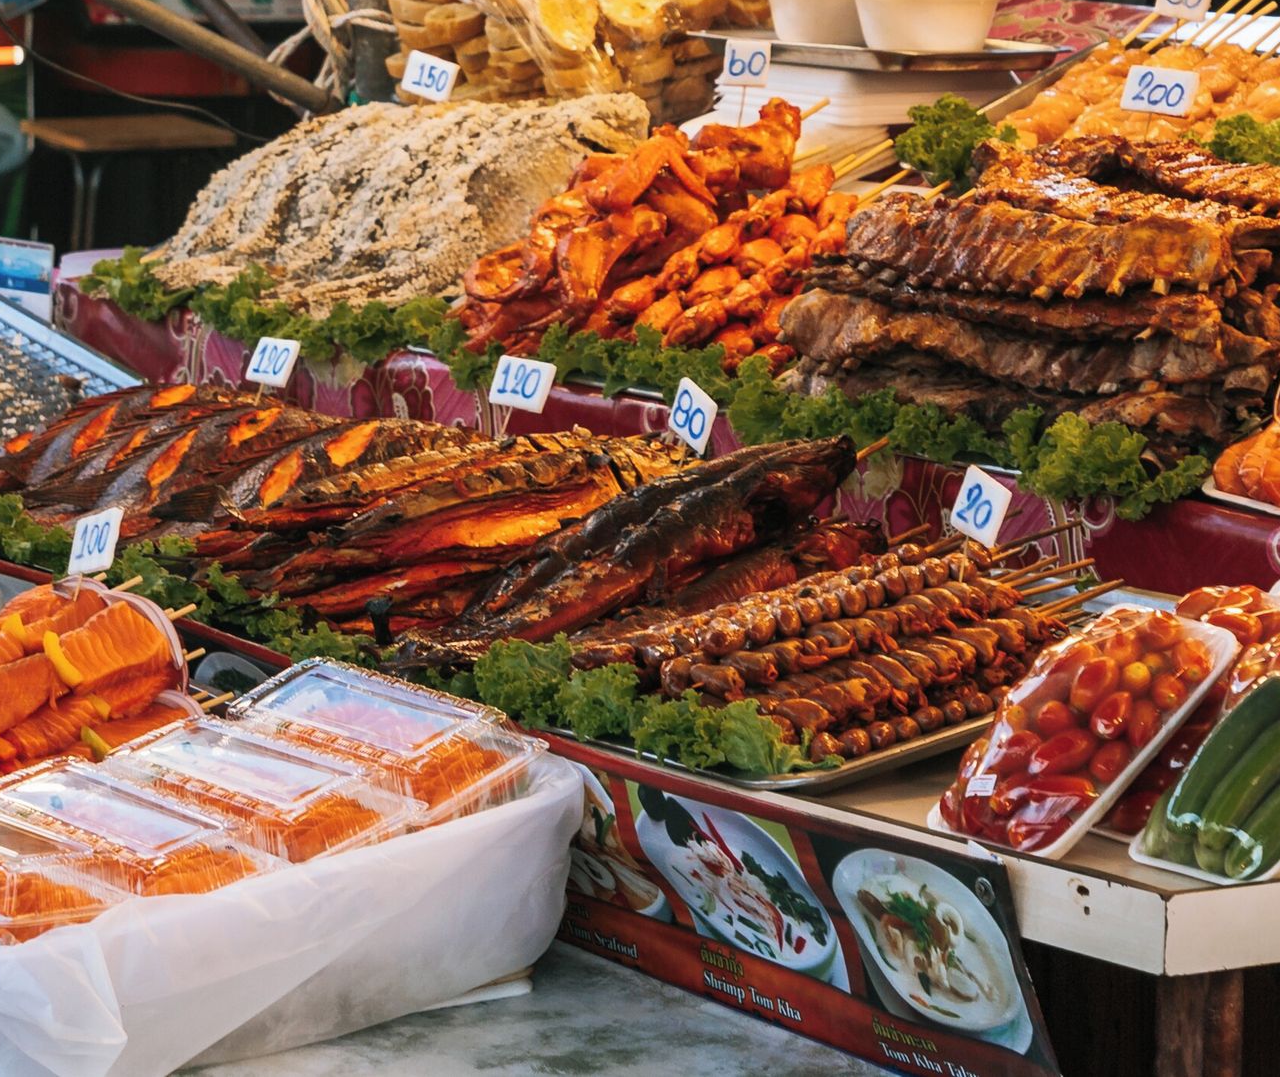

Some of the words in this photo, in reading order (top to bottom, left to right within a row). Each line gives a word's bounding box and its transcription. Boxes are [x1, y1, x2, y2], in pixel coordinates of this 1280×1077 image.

[411, 62, 449, 93] 150
[728, 49, 767, 77] 60
[1131, 70, 1186, 109] 200
[496, 362, 542, 400] 120
[672, 388, 707, 441] 80
[956, 482, 993, 530] 20
[74, 521, 111, 561] 100
[594, 932, 638, 957] Seafood
[704, 970, 745, 1004] Shrimp
[748, 986, 774, 1010] Tom
[777, 998, 802, 1021] Kha
[879, 1041, 910, 1064] Tom
[912, 1050, 943, 1074] Kha
